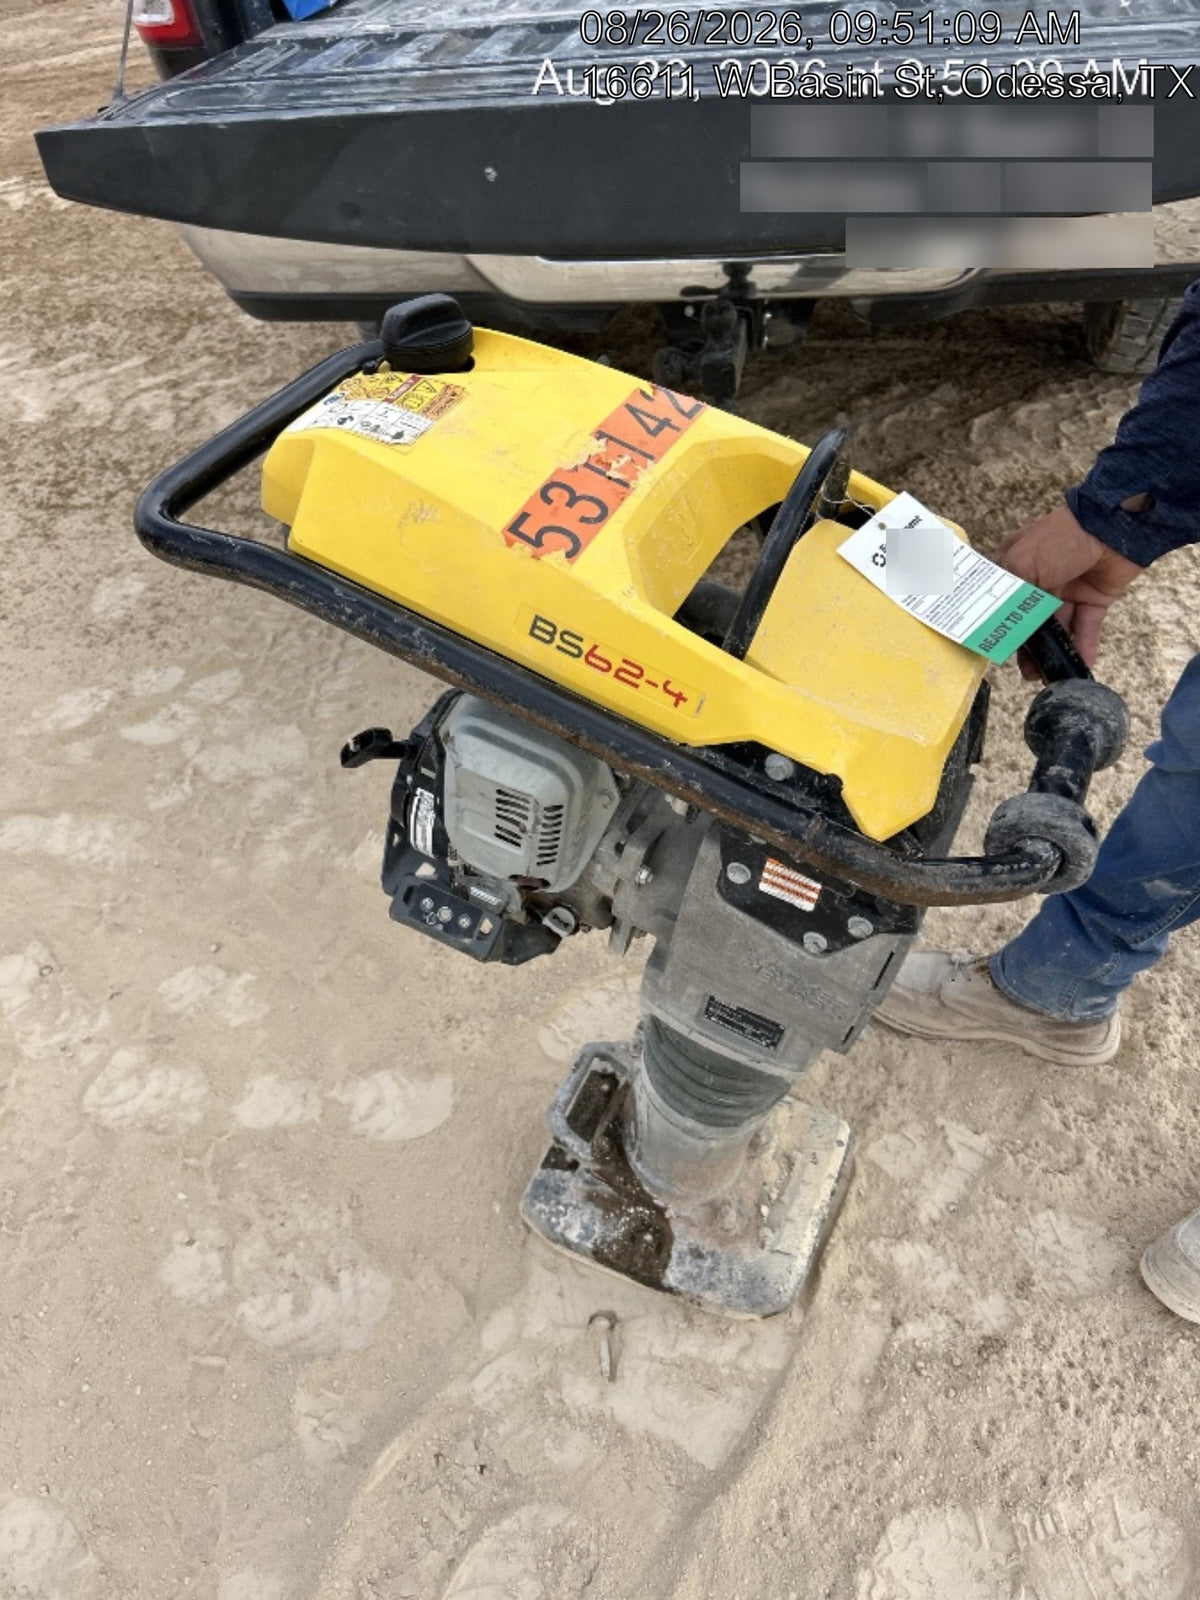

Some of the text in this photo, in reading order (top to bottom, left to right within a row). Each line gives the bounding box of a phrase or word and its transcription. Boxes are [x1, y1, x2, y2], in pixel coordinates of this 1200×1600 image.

[507, 387, 704, 560] 531142
[528, 614, 689, 708] BS62-4
[978, 590, 1045, 653] READY TO RENT
